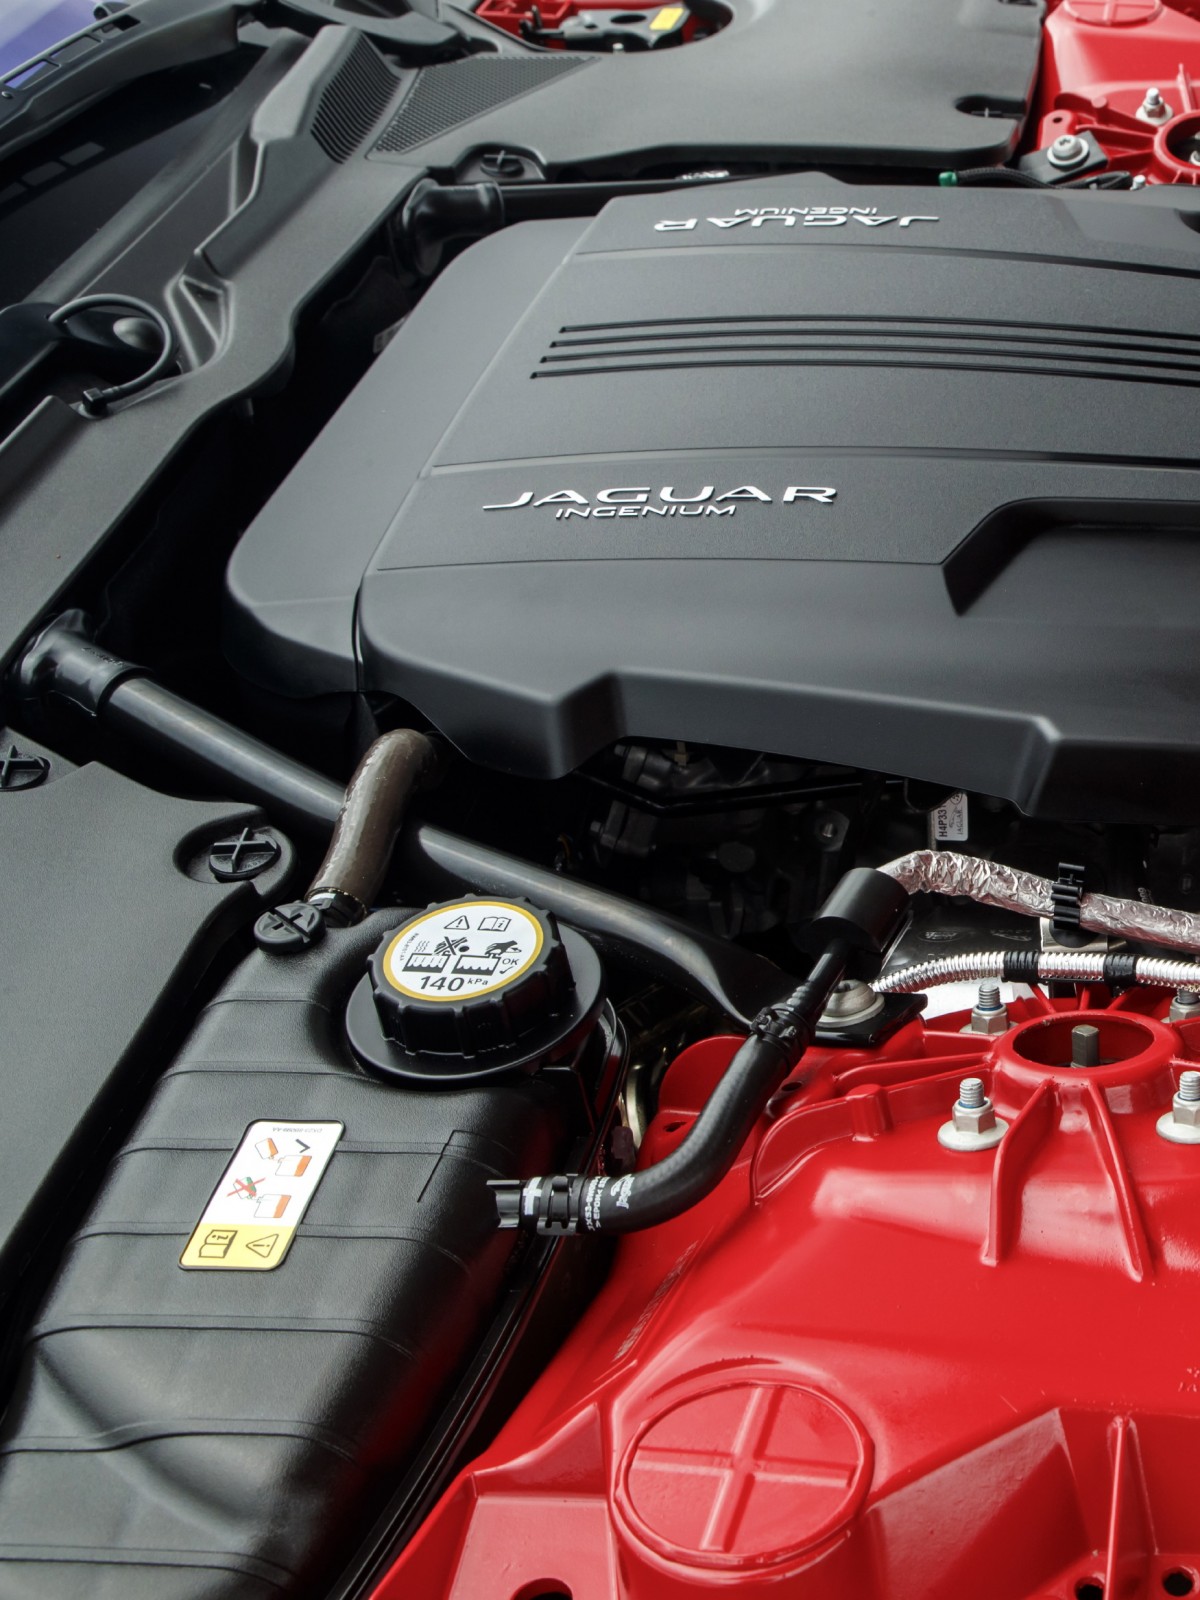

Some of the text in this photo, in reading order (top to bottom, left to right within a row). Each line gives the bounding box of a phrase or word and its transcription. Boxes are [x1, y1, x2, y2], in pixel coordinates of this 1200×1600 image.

[733, 206, 878, 216] INGENIUM
[652, 214, 940, 232] JAGUAR
[482, 485, 838, 510] JAGUAR
[554, 504, 737, 519] INGENIUM
[501, 957, 519, 966] OK
[419, 975, 489, 992] 140 kPa
